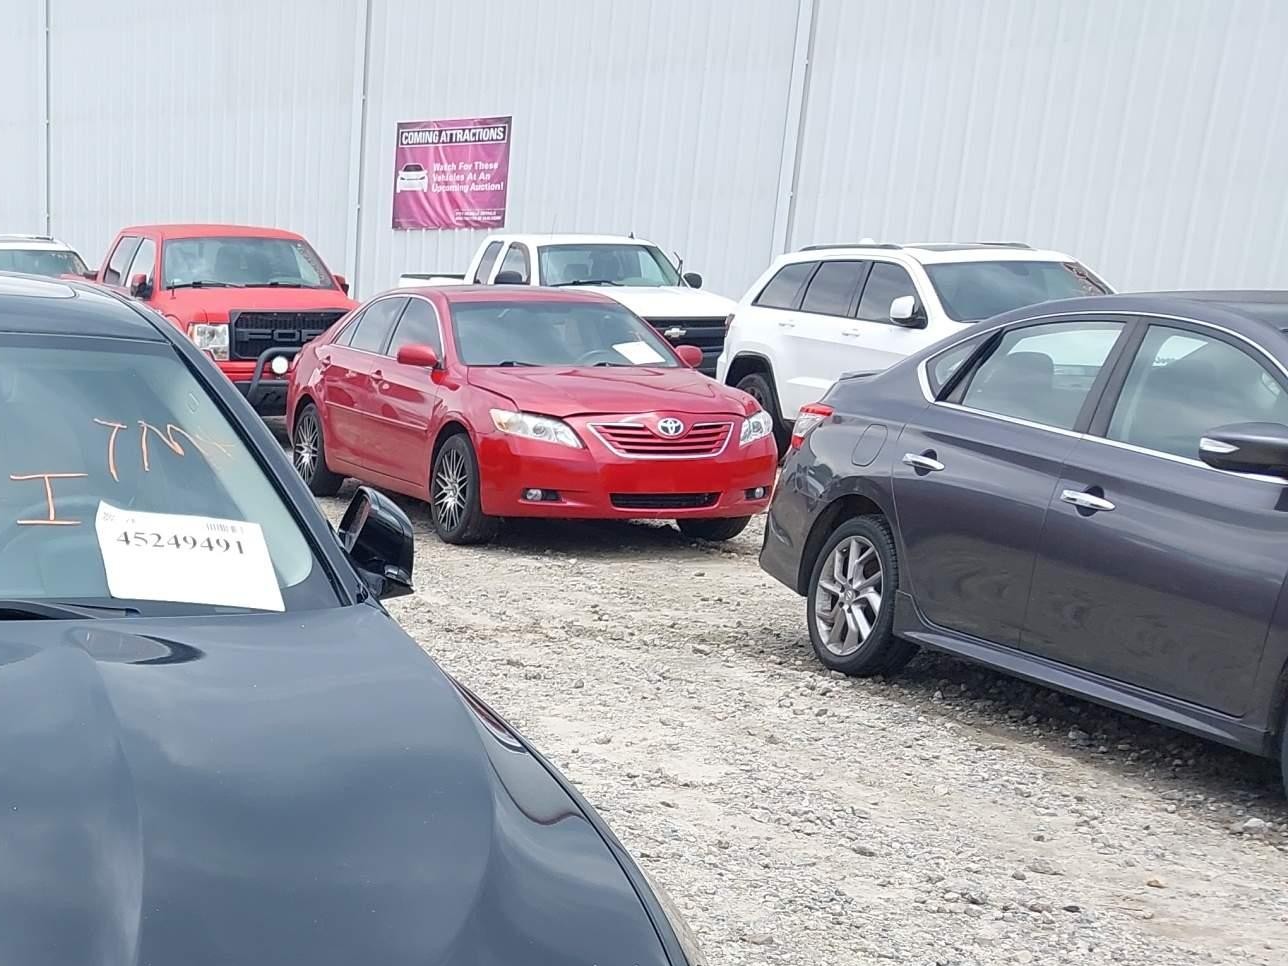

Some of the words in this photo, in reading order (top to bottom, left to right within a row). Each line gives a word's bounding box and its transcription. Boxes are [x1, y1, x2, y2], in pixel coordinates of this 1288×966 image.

[402, 130, 439, 144] COMING
[440, 127, 504, 143] ATTRACTIONS
[433, 162, 456, 171] Watch
[458, 161, 472, 170] For
[474, 161, 498, 170] These
[432, 173, 464, 182] Vehicles
[466, 172, 477, 181] At
[478, 172, 490, 181] An
[432, 183, 469, 193] Upcoming
[470, 181, 504, 191] Auction!
[235, 328, 325, 342] FO
[116, 531, 245, 554] 45249491
